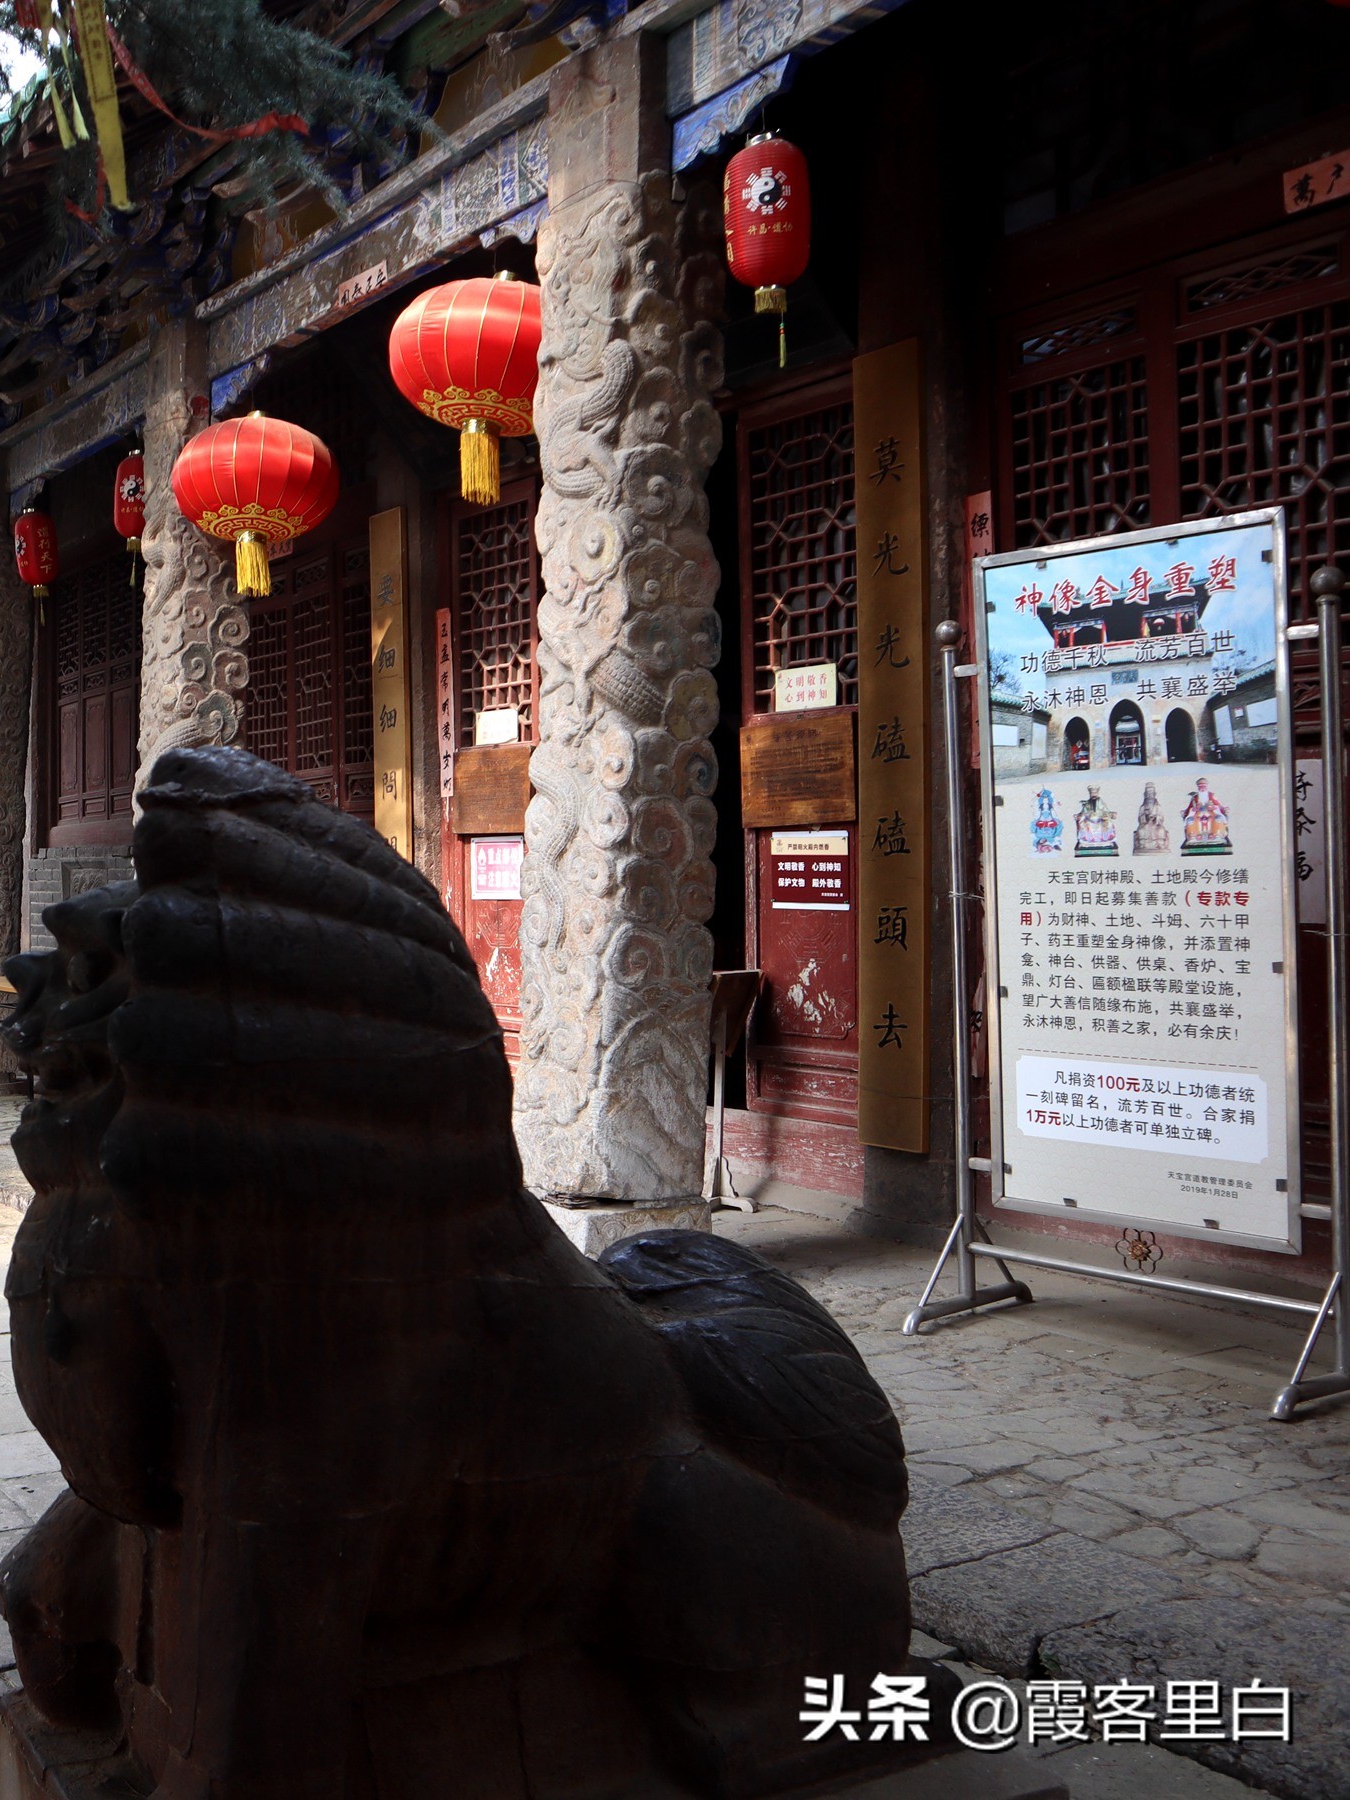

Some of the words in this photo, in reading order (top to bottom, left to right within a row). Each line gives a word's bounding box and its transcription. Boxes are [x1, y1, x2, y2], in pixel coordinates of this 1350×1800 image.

[1014, 553, 1238, 616] 神像金身重塑
[1020, 647, 1108, 674] 功德千秋
[1134, 629, 1236, 662] 流芳百世
[785, 672, 827, 689] 文明敬香
[785, 689, 827, 703] 心到神知
[1020, 684, 1109, 714] 永沐神恩
[1136, 671, 1237, 701] 共襄盛举
[777, 862, 805, 872] 文明敬香
[811, 862, 842, 872] 心到神知
[1047, 868, 1250, 886] 天宝宫财神殿、土地殿今修缮
[777, 878, 806, 888] 保护文物
[811, 878, 842, 889] 殿外敬香
[1020, 932, 1251, 952] 子、药王重塑金身神像，并添置神
[1022, 993, 1243, 1019] 望广大善信随缘布施，共襄盛举，
[1054, 1070, 1256, 1103] 凡捐资100元及以上功德者统
[1025, 1090, 1256, 1126] 一刻碑留名，流芳百世。合家捐
[1026, 1109, 1222, 1146] 1万元以上功德者可单独立碑。
[1167, 1170, 1253, 1191] 天宝宫道教管理委员会
[1180, 1183, 1239, 1199] 2019年1月28日
